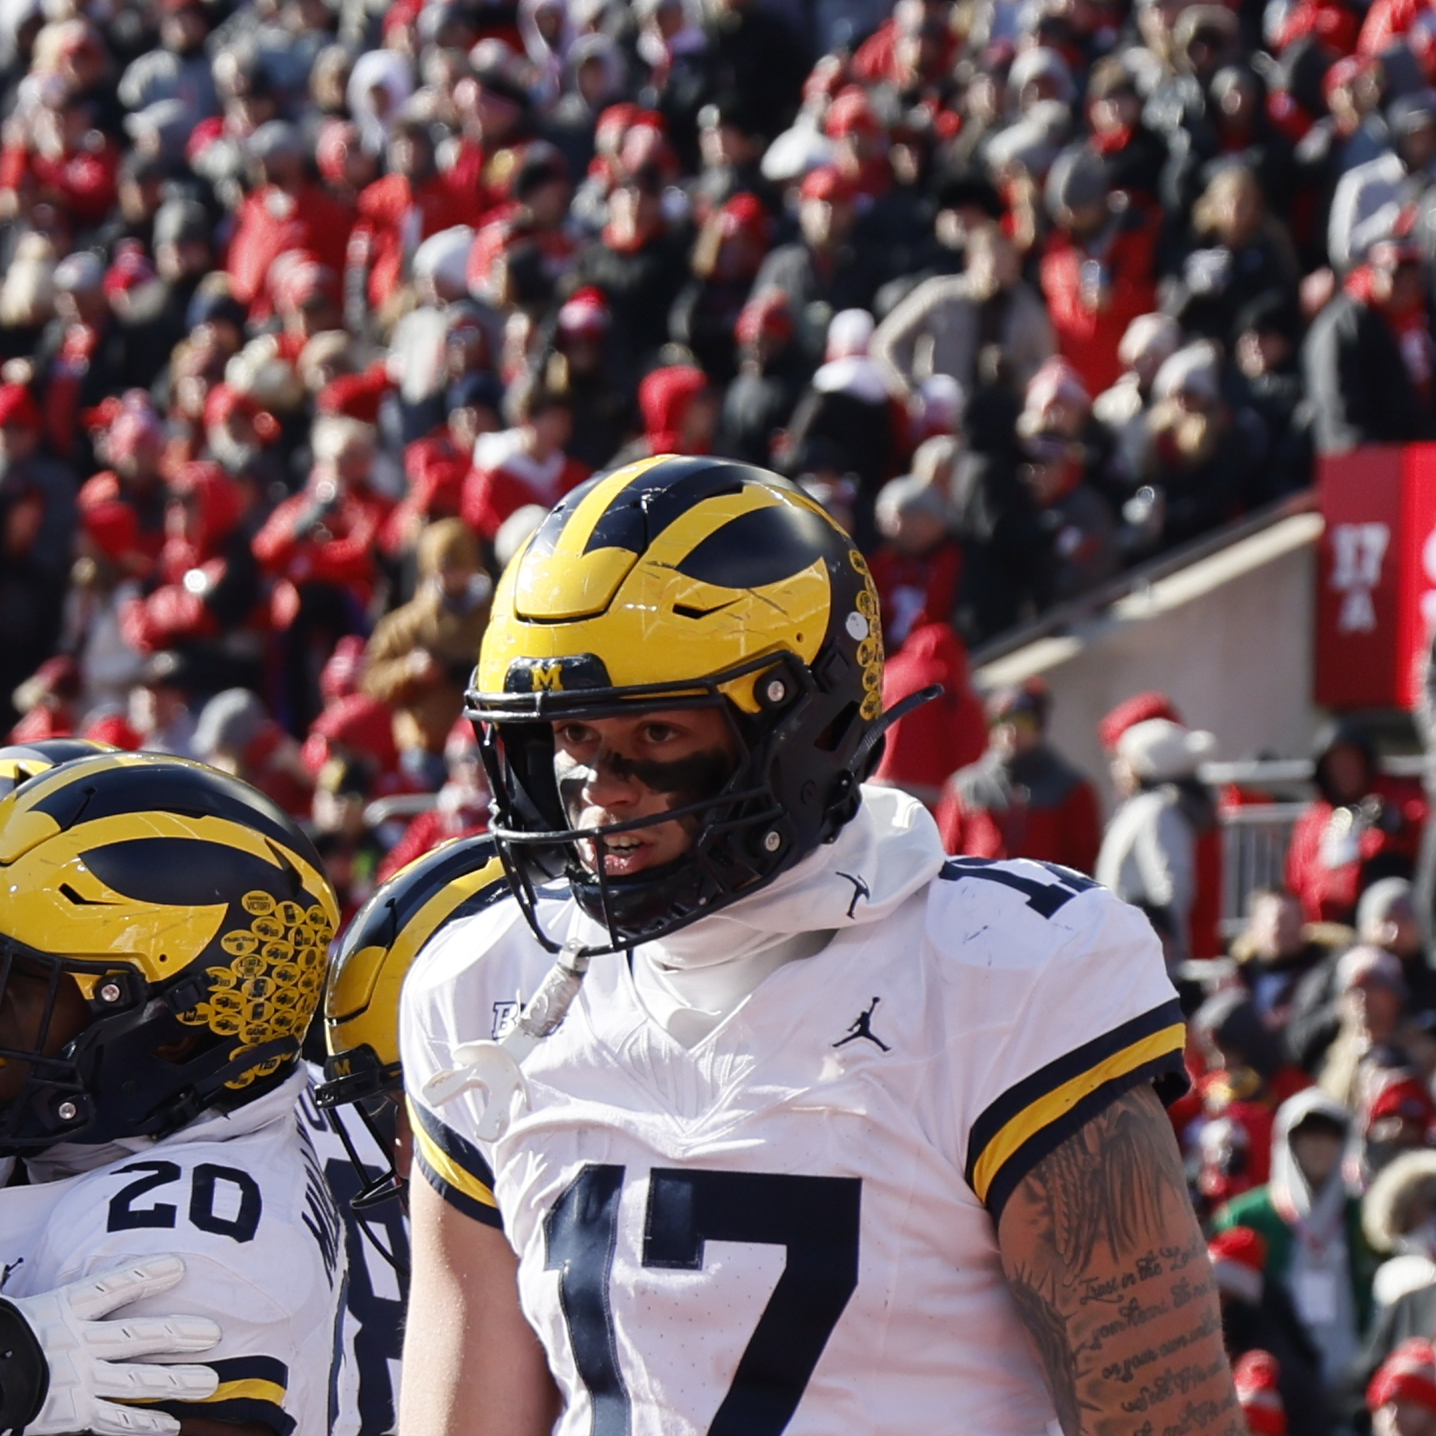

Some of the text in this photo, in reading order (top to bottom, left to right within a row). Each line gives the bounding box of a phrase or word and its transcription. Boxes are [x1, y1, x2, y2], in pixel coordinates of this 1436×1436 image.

[531, 664, 564, 691] M
[334, 1058, 351, 1076] M
[106, 1160, 263, 1243] 20
